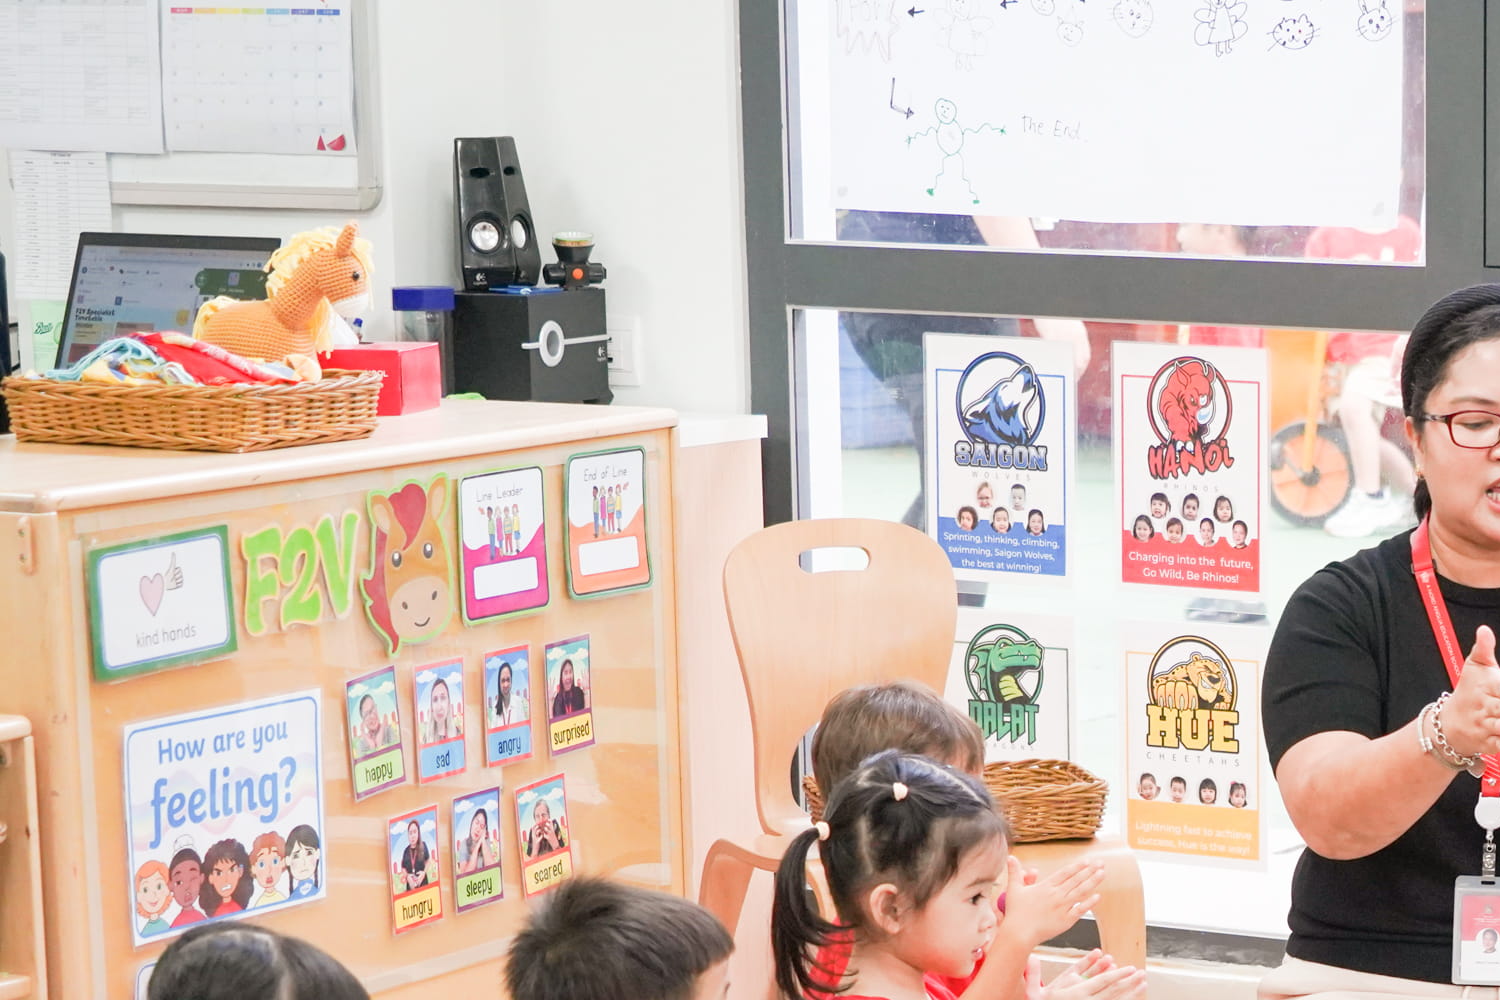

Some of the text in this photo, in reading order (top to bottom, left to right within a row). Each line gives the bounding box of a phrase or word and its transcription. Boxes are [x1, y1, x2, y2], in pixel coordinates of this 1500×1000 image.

[1022, 115, 1044, 134] The
[954, 440, 1048, 472] SAIGON
[584, 465, 627, 482] End of Line
[476, 484, 524, 502] Line Leader
[943, 532, 1060, 549] Sprinting, thinking, climbing,
[948, 545, 1055, 562] swimming, Saigon Wolves,
[1128, 552, 1253, 570] Charging into the future,
[242, 510, 360, 637] F2V
[962, 559, 1042, 574] the best at winning!
[1143, 568, 1239, 584] Go Wild, Be Rhinos!
[136, 624, 197, 648] kind hands
[554, 721, 590, 746] surprised
[1146, 703, 1239, 754] HUE
[158, 721, 288, 765] How are you
[498, 735, 521, 756] angry
[436, 751, 450, 768] sad
[1146, 752, 1240, 767] CHEETAHS
[365, 761, 393, 784] happy
[149, 756, 297, 849] feeling?
[534, 859, 563, 885] scared
[466, 878, 492, 897] sleepy
[402, 898, 433, 921] hungry
